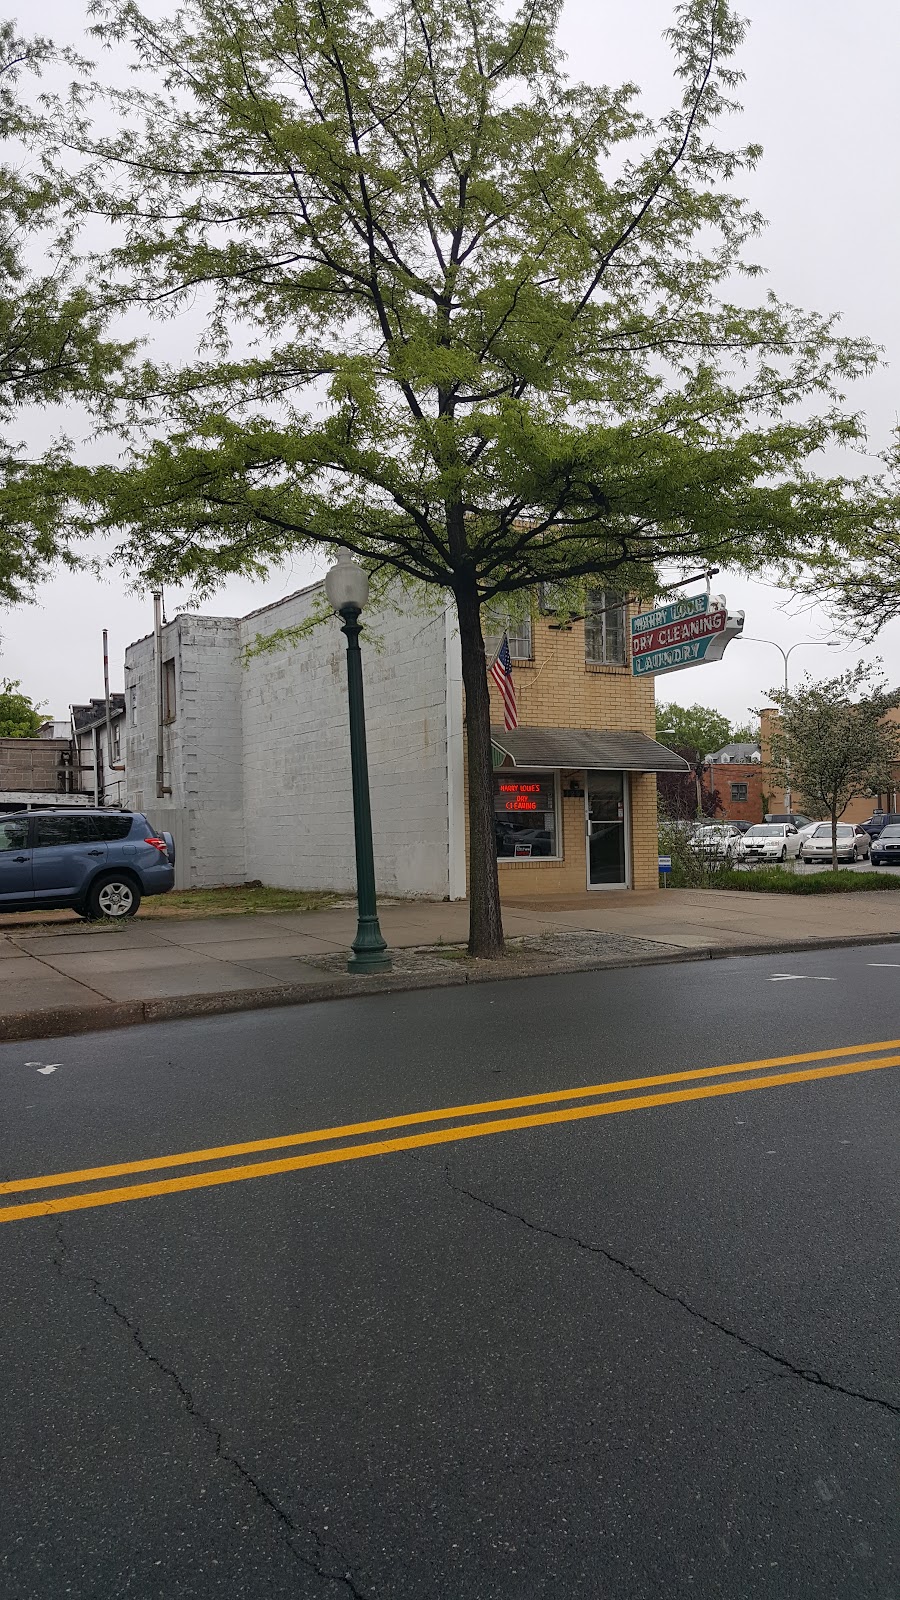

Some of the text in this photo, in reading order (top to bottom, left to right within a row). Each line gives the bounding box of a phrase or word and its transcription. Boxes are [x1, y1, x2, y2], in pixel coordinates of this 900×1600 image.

[633, 613, 721, 652] DRY CLEANING
[635, 643, 700, 672] LAUNDRY
